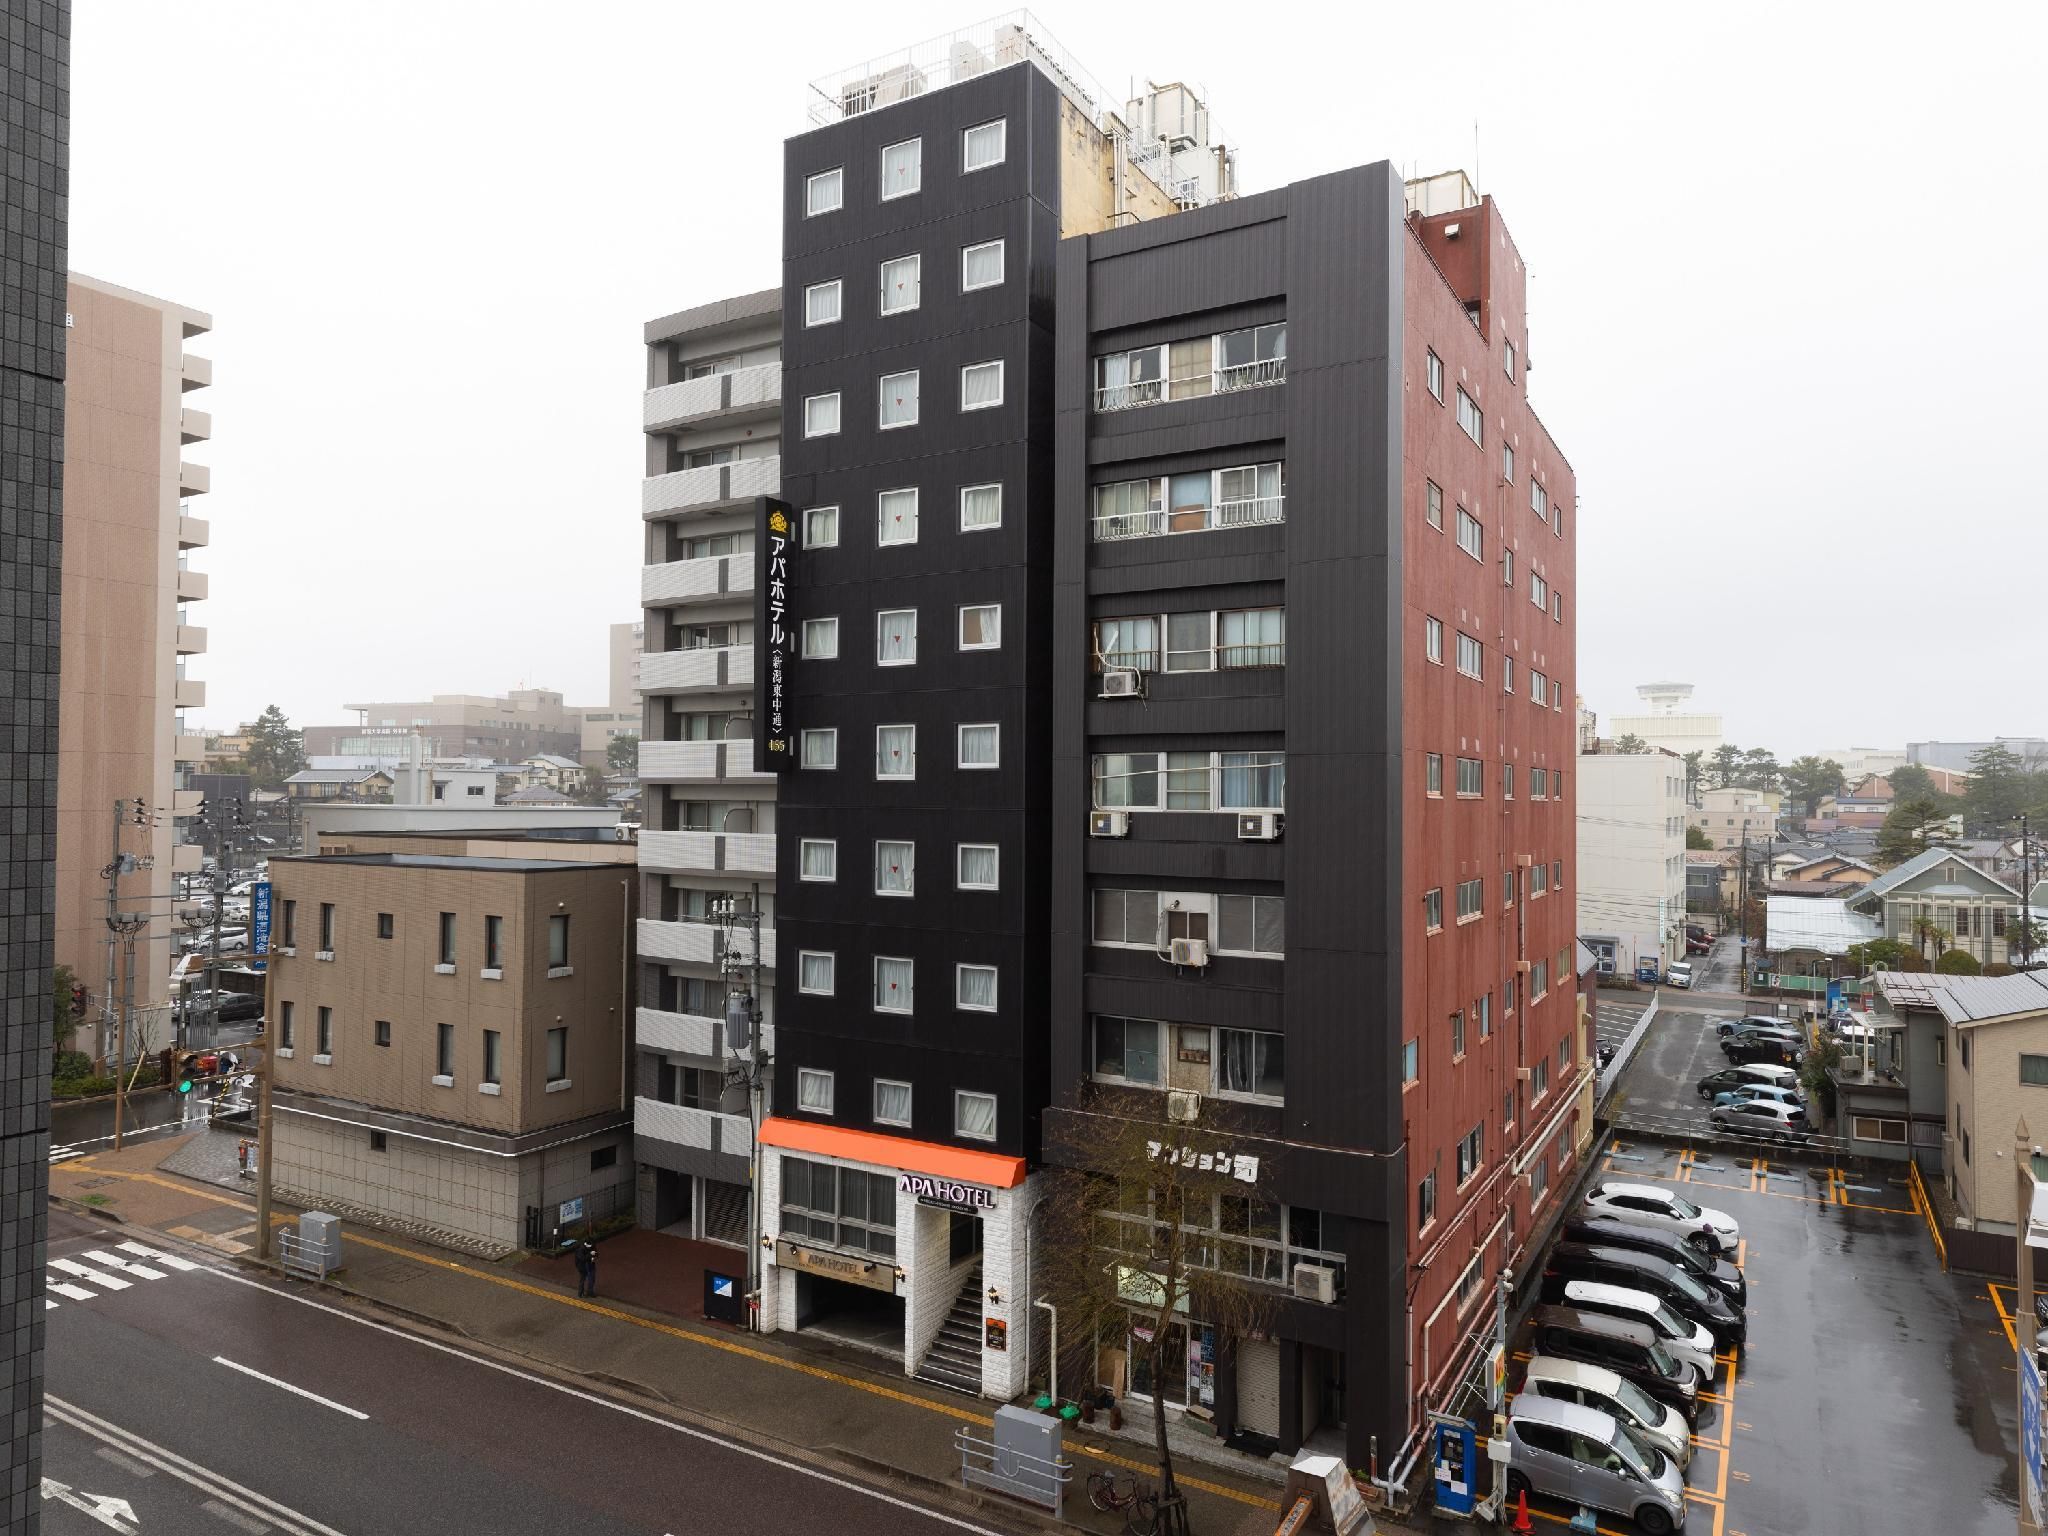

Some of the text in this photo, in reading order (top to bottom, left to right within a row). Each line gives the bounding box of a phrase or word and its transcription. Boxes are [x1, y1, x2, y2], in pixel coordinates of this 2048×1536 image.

[770, 536, 786, 645] アパホテル
[900, 1175, 935, 1198] APA
[937, 1180, 996, 1210] HOTEL
[807, 1254, 827, 1268] APA
[828, 1259, 860, 1275] HOTEL
